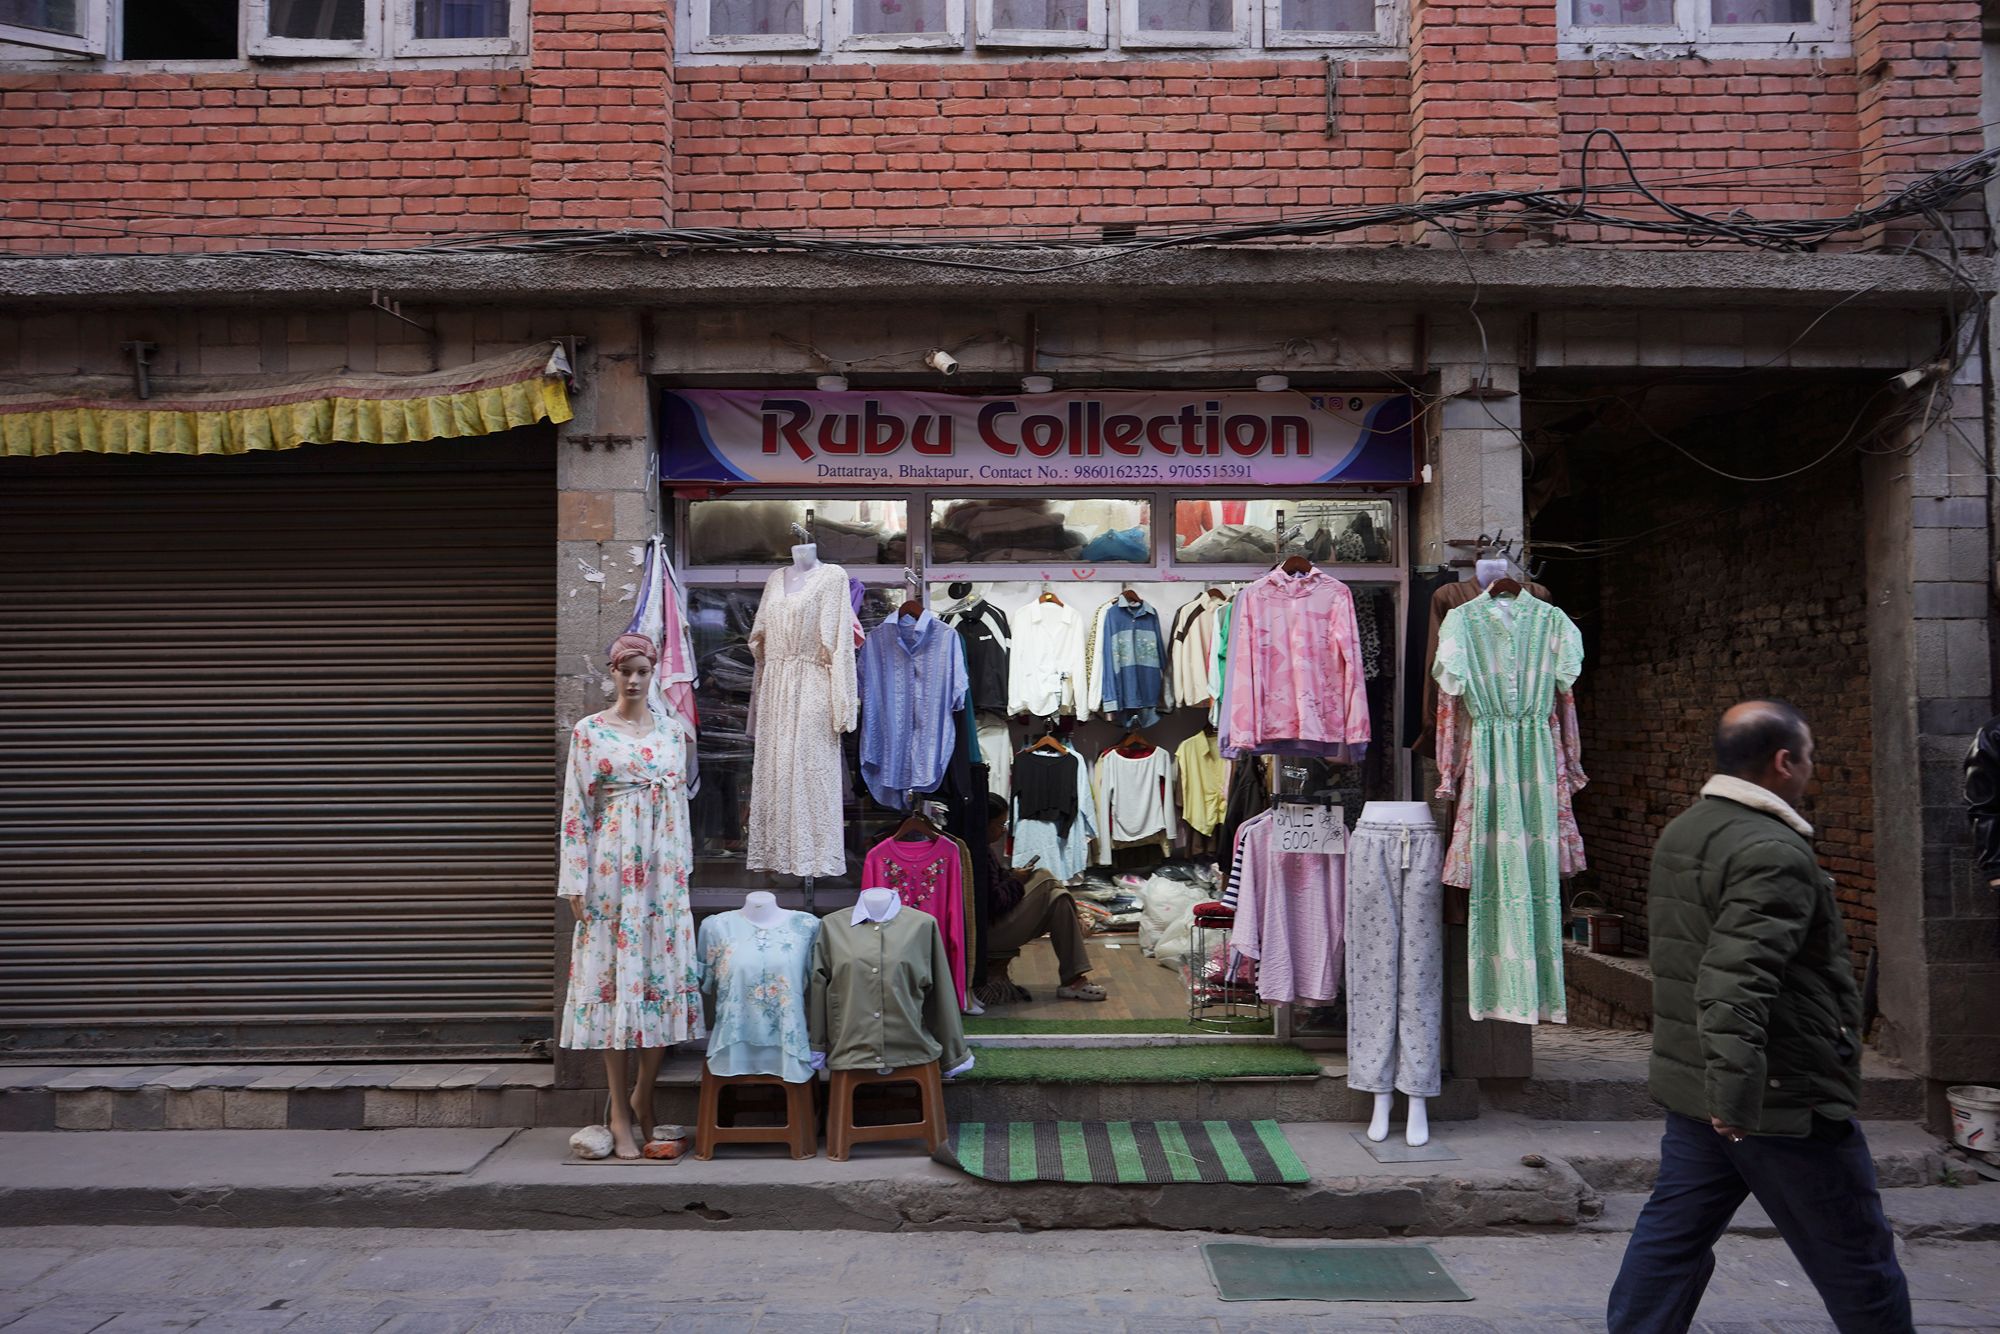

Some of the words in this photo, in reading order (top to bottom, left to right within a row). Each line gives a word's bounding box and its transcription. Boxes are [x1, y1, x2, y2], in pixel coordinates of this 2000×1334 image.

[760, 399, 954, 463] Rubu
[977, 400, 1312, 457] Collection
[817, 464, 893, 480] Dattatraya,
[899, 464, 974, 481] Bhaktapur,
[979, 465, 1032, 479] Contact
[1038, 465, 1068, 479] No.:
[1074, 465, 1163, 480] 9860162325,
[1169, 465, 1252, 479] 9705515391
[1277, 806, 1314, 828] SALE
